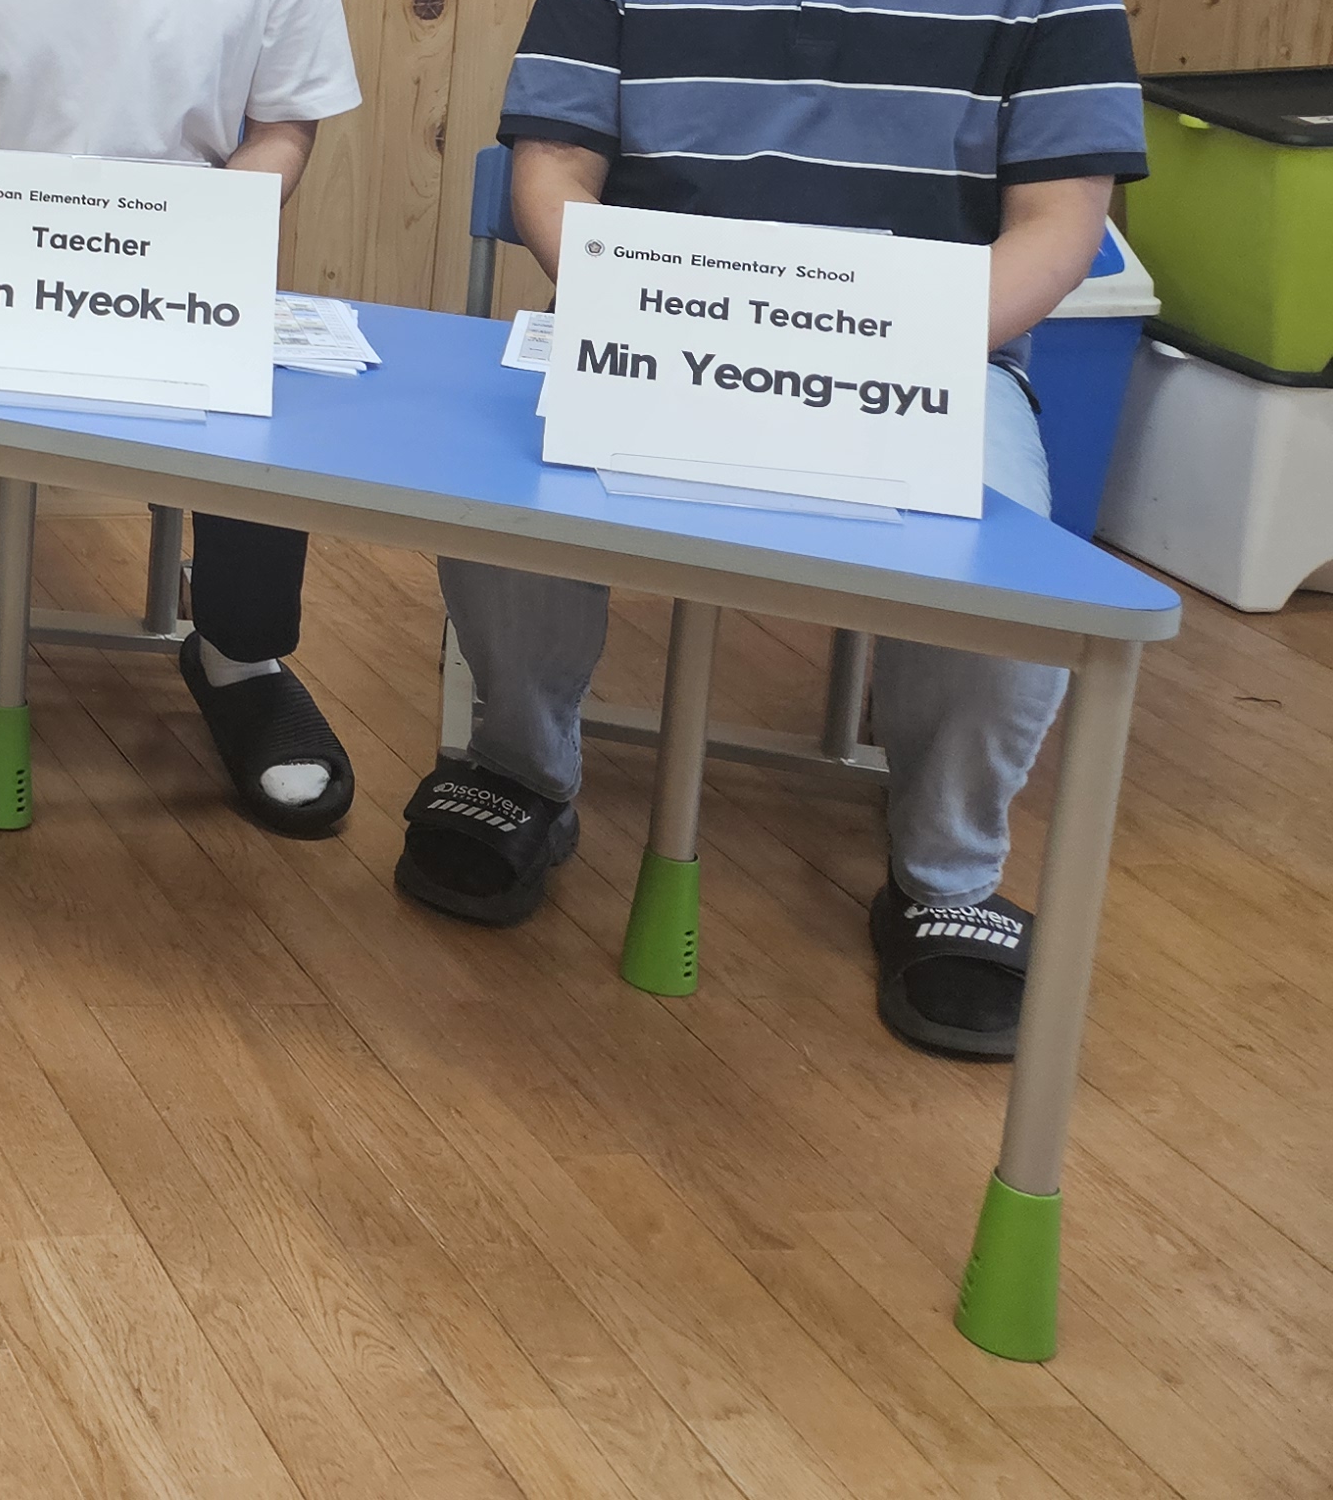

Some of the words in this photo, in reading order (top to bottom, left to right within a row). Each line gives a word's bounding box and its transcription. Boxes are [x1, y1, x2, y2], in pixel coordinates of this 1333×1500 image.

[29, 190, 110, 209] Elementary
[118, 197, 167, 212] School
[32, 226, 151, 257] Taecher
[613, 246, 682, 265] Gumban
[691, 254, 786, 277] Elementary
[796, 266, 855, 283] School
[35, 279, 240, 327] Hyeok-ho
[639, 288, 730, 321] Head
[748, 300, 893, 337] Teacher
[577, 339, 658, 381] Min
[682, 350, 949, 417] Yeong-gyu
